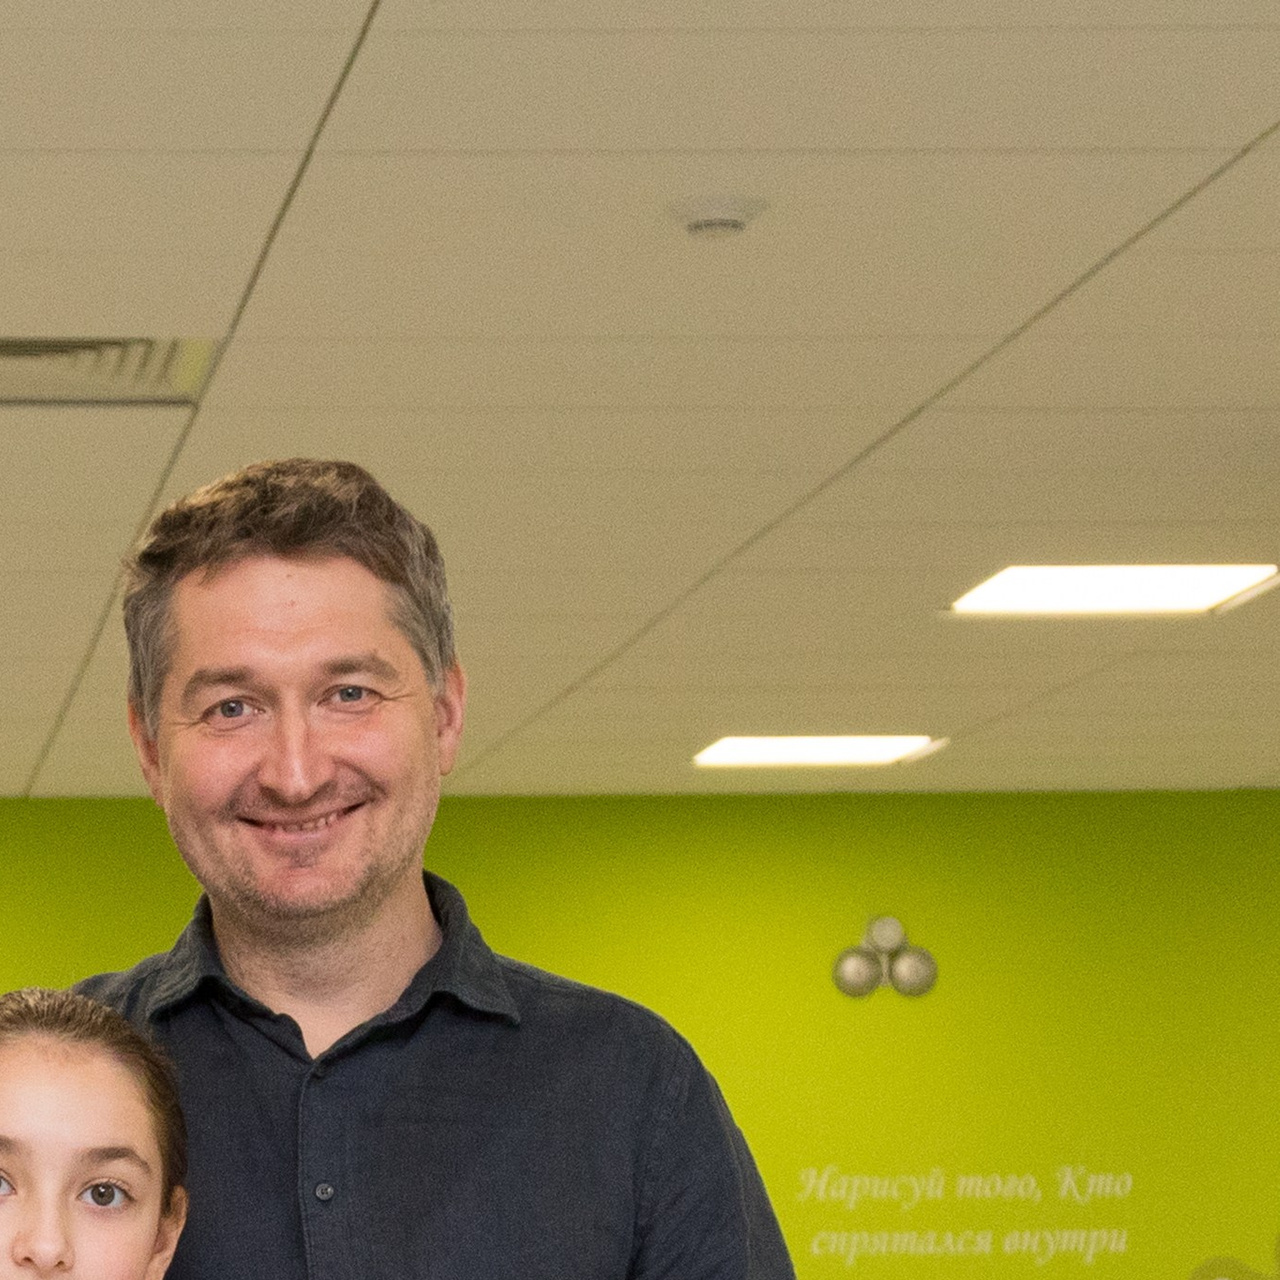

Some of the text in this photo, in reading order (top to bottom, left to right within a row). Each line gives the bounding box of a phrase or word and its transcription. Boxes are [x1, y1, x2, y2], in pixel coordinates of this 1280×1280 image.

[795, 1163, 1134, 1212] Нарисуй того, Кто
[809, 1228, 1129, 1268] спрятался внутри
